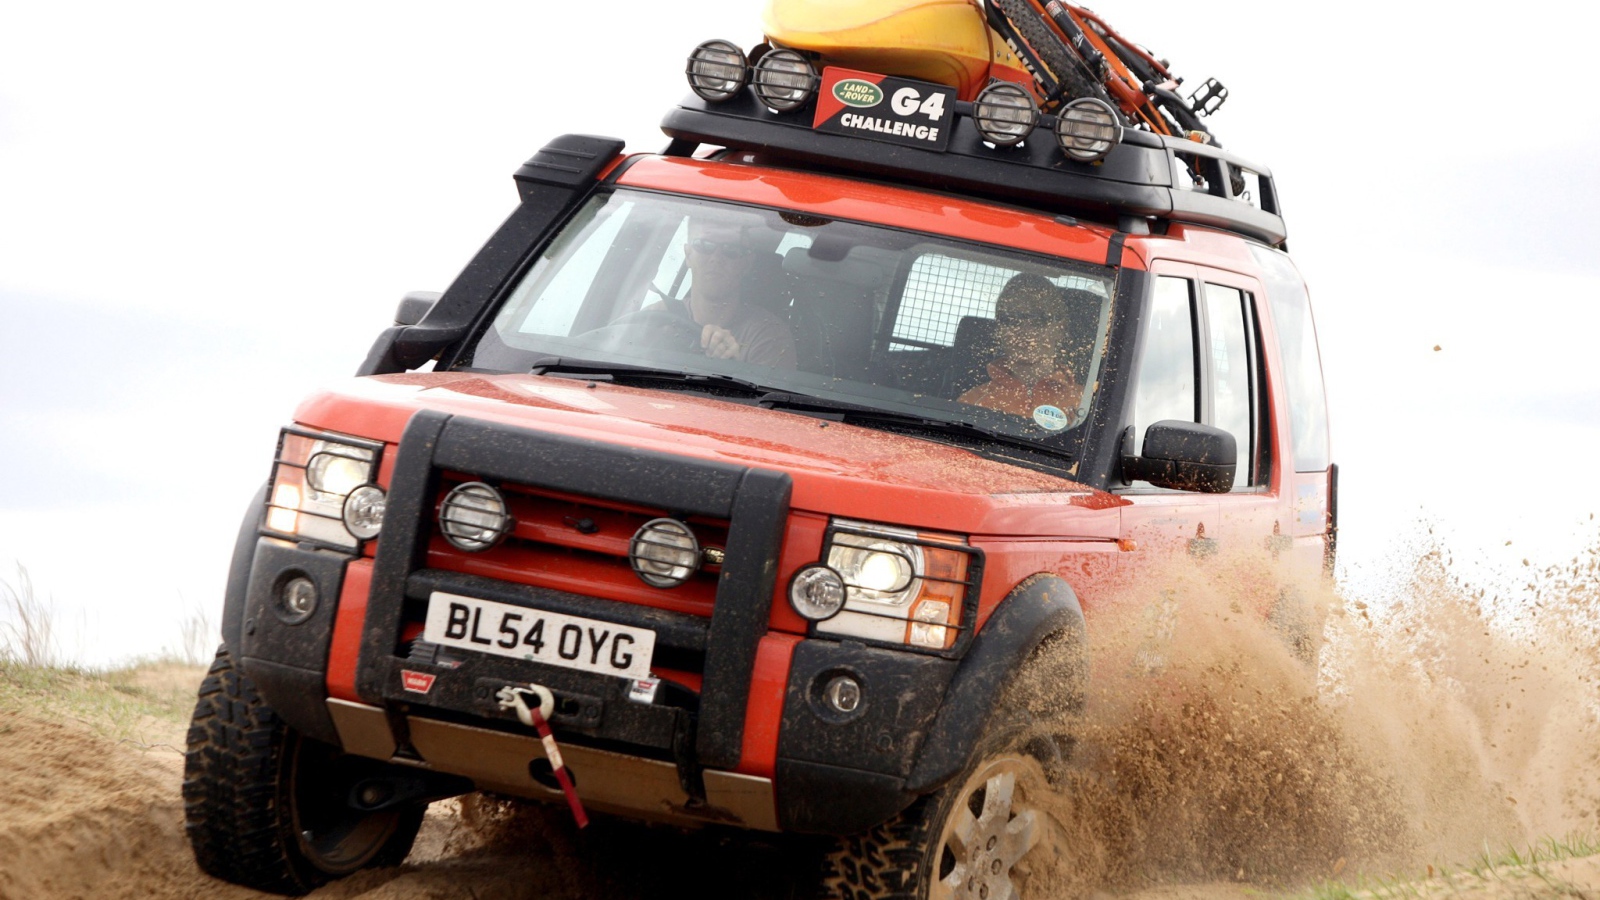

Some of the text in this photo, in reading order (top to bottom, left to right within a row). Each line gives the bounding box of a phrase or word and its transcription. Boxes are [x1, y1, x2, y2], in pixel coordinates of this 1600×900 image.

[843, 82, 868, 94] LAND
[844, 92, 875, 103] ROVER
[891, 87, 946, 121] G4
[840, 113, 939, 142] CHALLENGE
[445, 602, 545, 654] BL54
